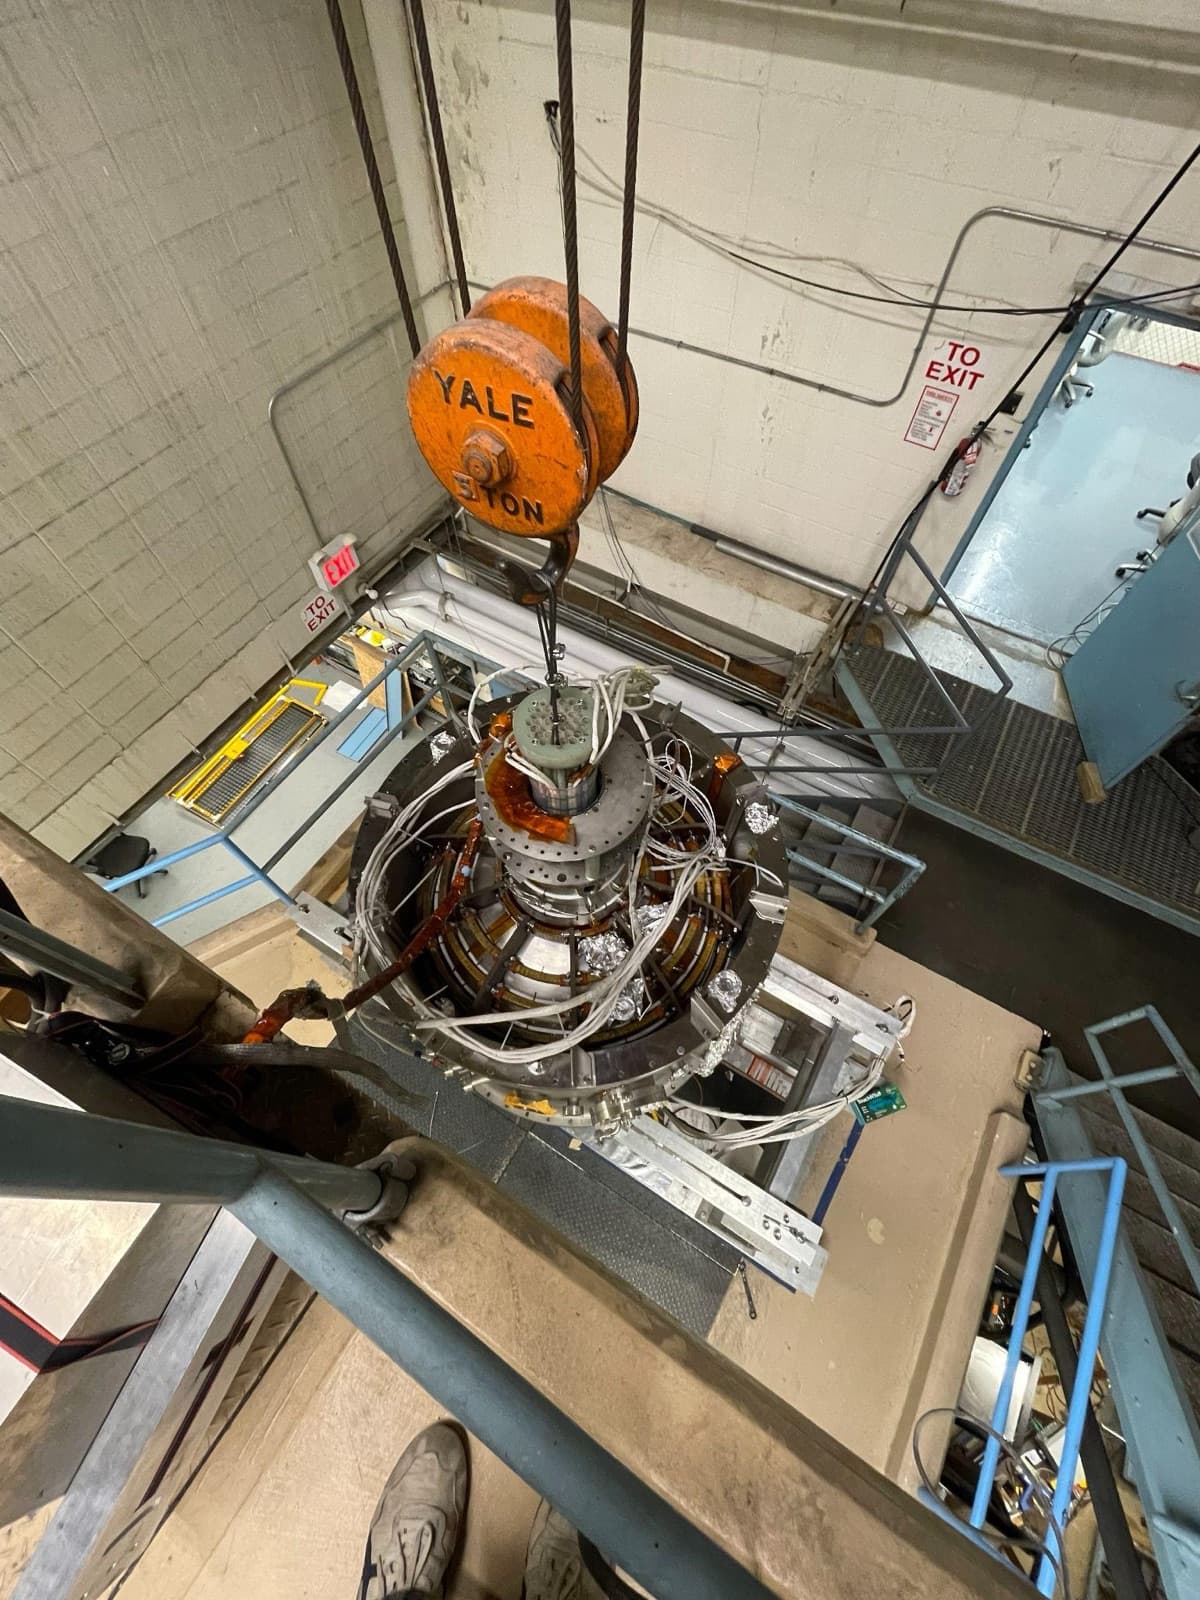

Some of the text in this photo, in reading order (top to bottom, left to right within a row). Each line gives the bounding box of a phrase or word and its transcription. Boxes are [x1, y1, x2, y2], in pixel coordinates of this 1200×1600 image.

[948, 341, 981, 366] TO
[925, 360, 985, 390] EXIT
[433, 368, 535, 429] YALE
[479, 485, 544, 526] TON
[306, 595, 326, 616] TO
[307, 599, 336, 632] EXIT
